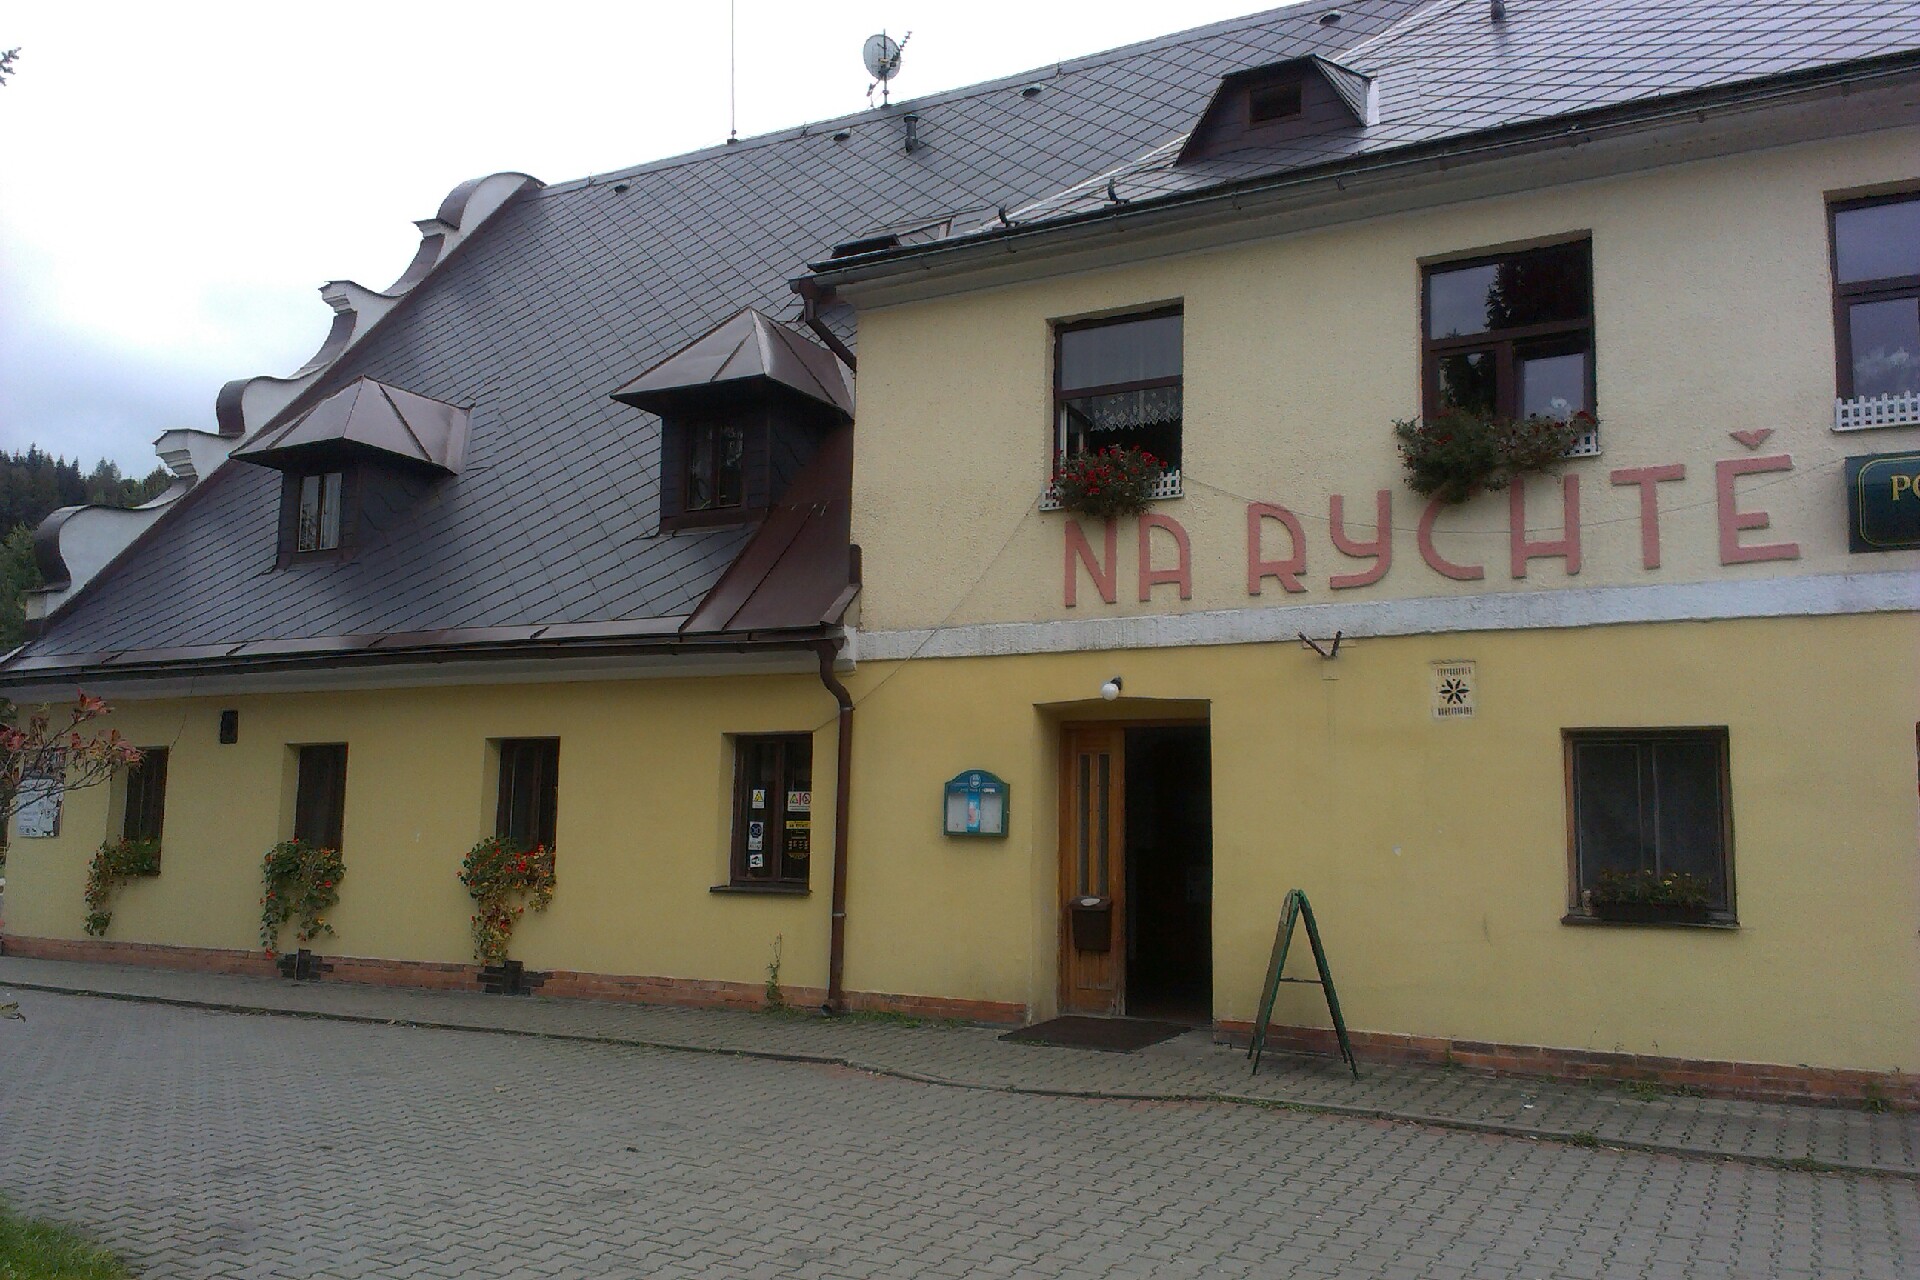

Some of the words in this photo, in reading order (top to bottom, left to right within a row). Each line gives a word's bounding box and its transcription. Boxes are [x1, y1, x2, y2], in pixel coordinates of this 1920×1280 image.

[1065, 514, 1192, 608] NA
[1247, 429, 1801, 597] RYCHTĚ
[1890, 473, 1920, 501] P
